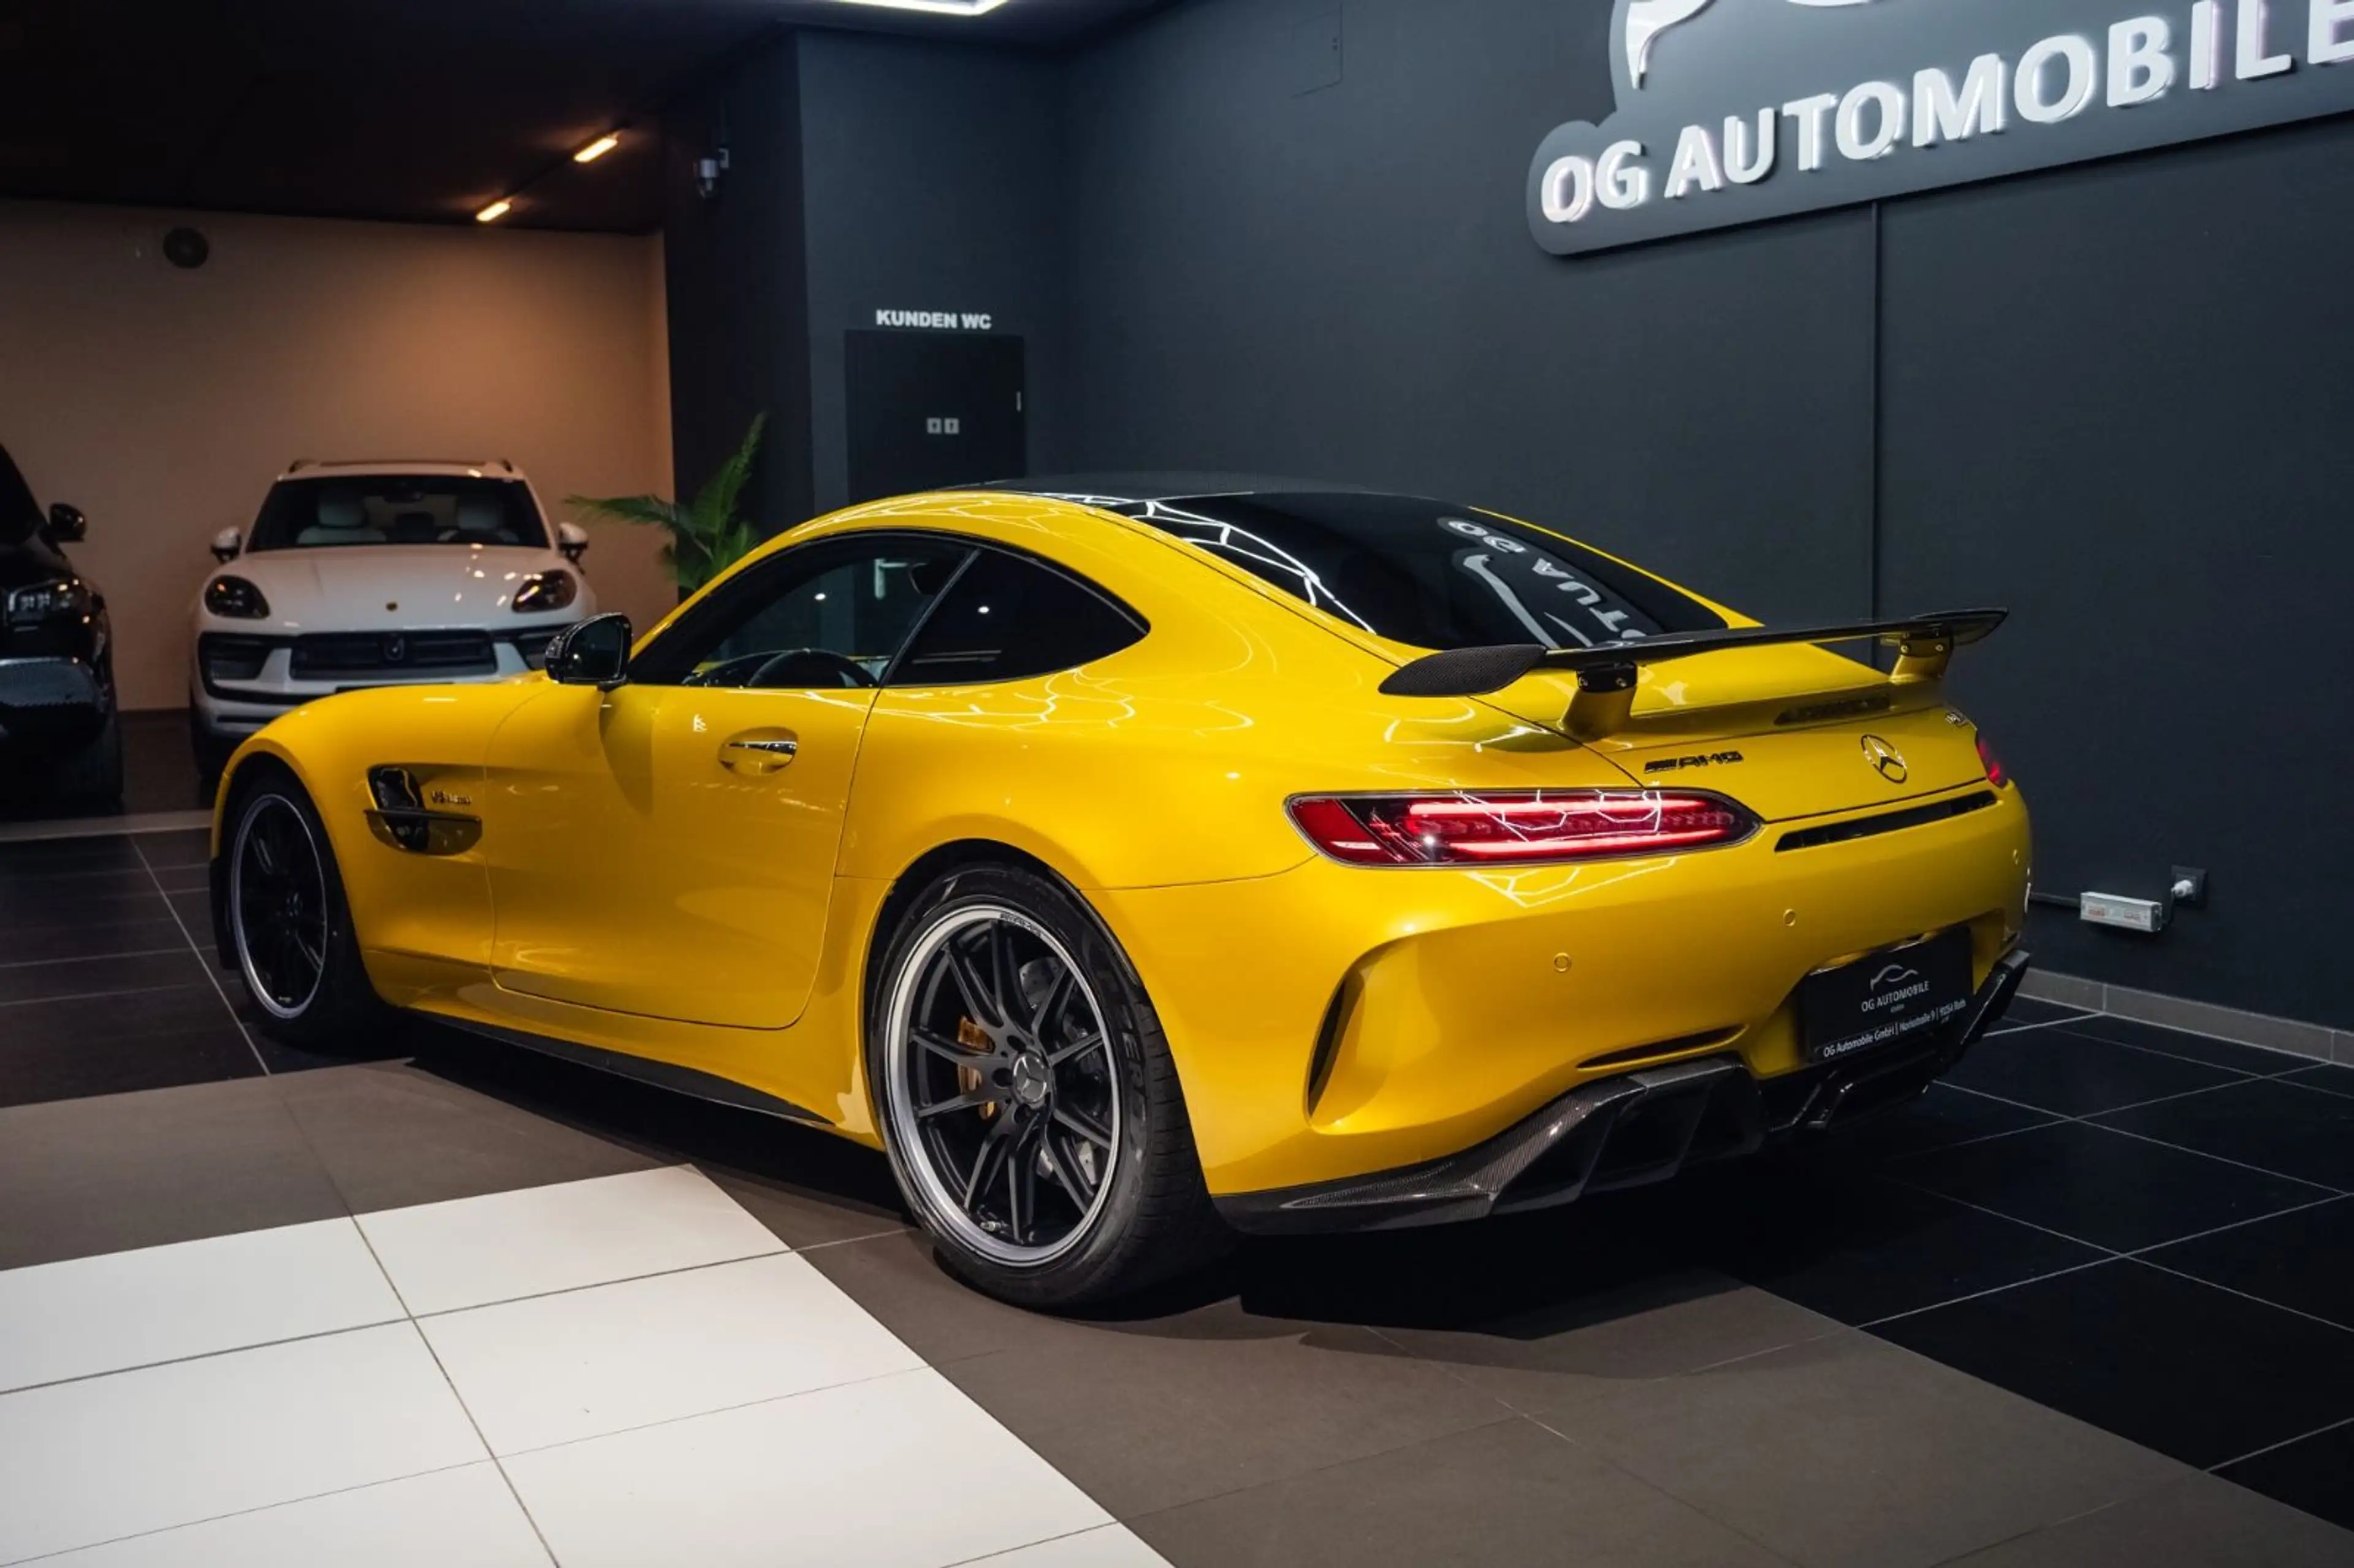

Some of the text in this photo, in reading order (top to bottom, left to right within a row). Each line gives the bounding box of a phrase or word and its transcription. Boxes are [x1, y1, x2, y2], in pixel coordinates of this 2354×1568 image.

[1541, 140, 1649, 223] OG
[876, 310, 992, 329] KUNDEN WC
[1861, 999, 1875, 1012] OG
[1877, 981, 1929, 1007] AUTOMOBILE
[1824, 1045, 1835, 1057] OG
[1837, 1033, 1873, 1053] Automobile
